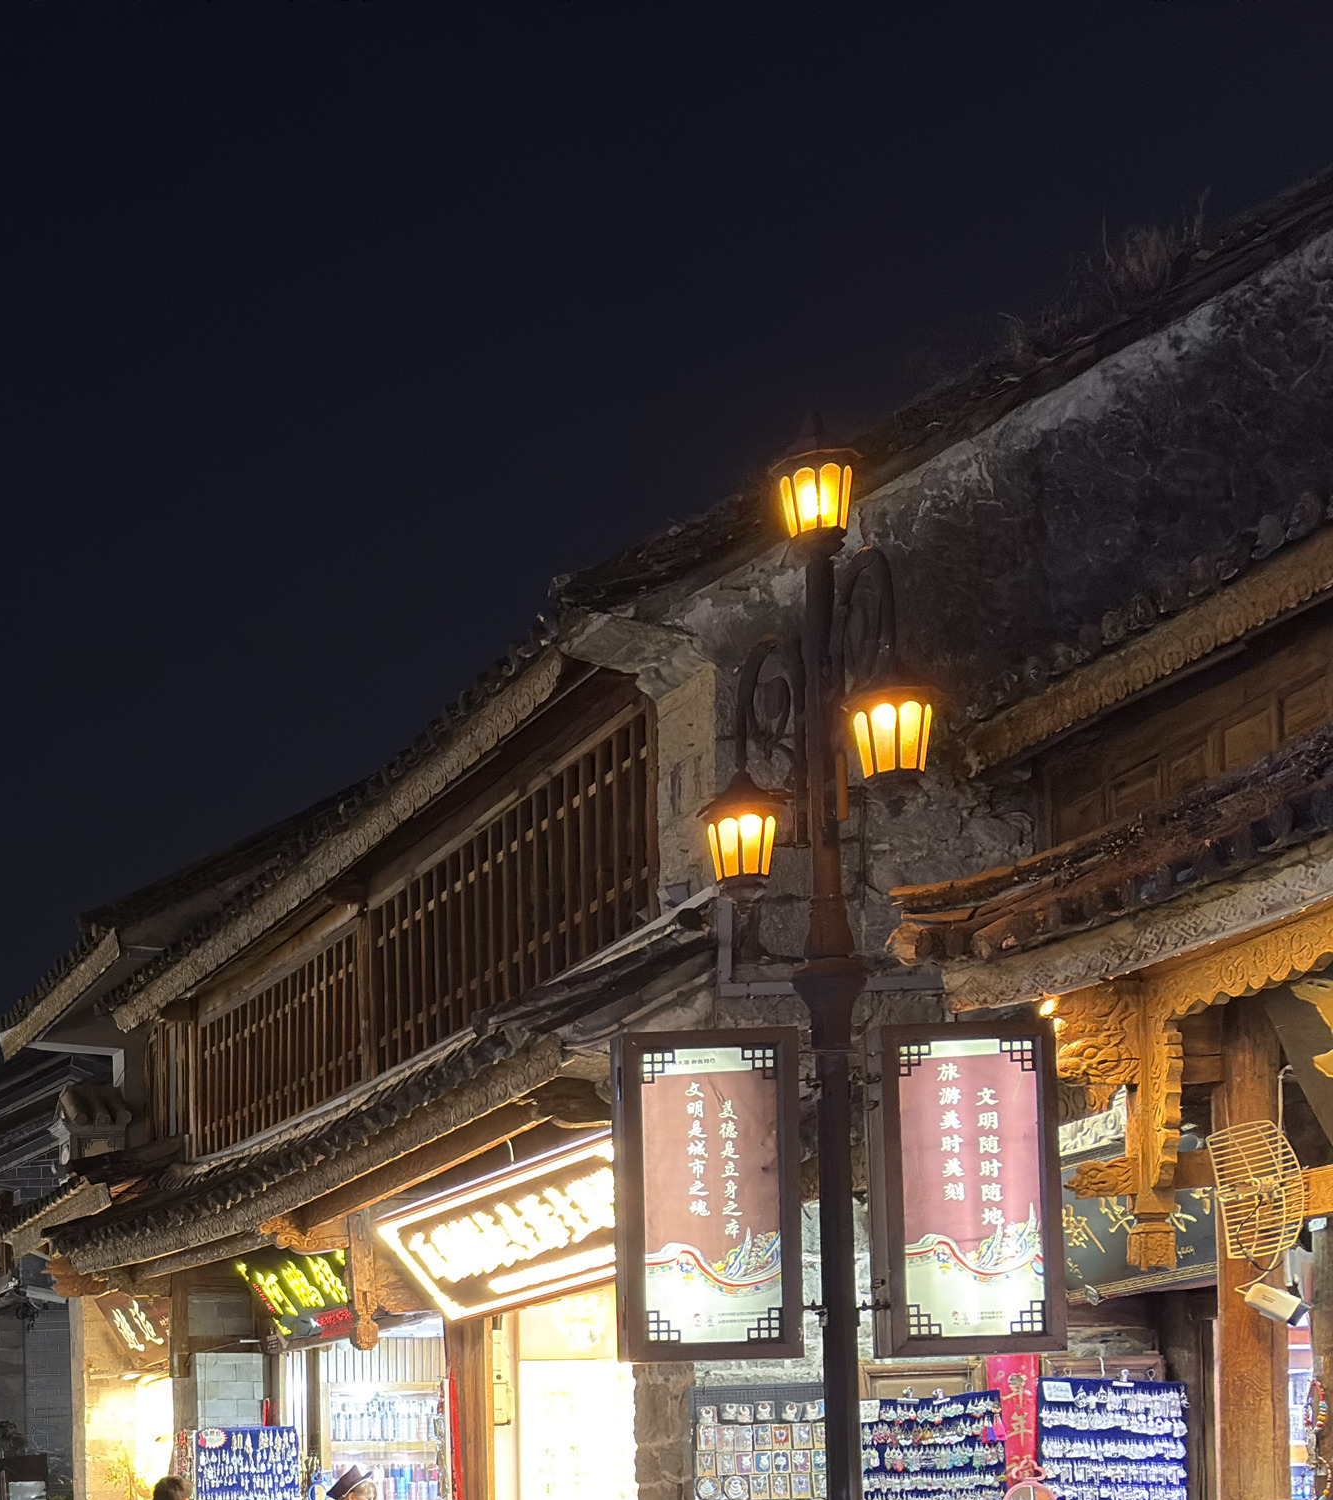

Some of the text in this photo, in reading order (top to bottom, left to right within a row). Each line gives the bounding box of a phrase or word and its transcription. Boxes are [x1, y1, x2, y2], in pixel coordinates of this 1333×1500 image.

[685, 1081, 711, 1217] 文明是城市之魂
[719, 1100, 743, 1239] 美德是立身之本
[936, 1062, 965, 1201] 旅游美时美刻
[975, 1087, 1005, 1226] 文明随时随地
